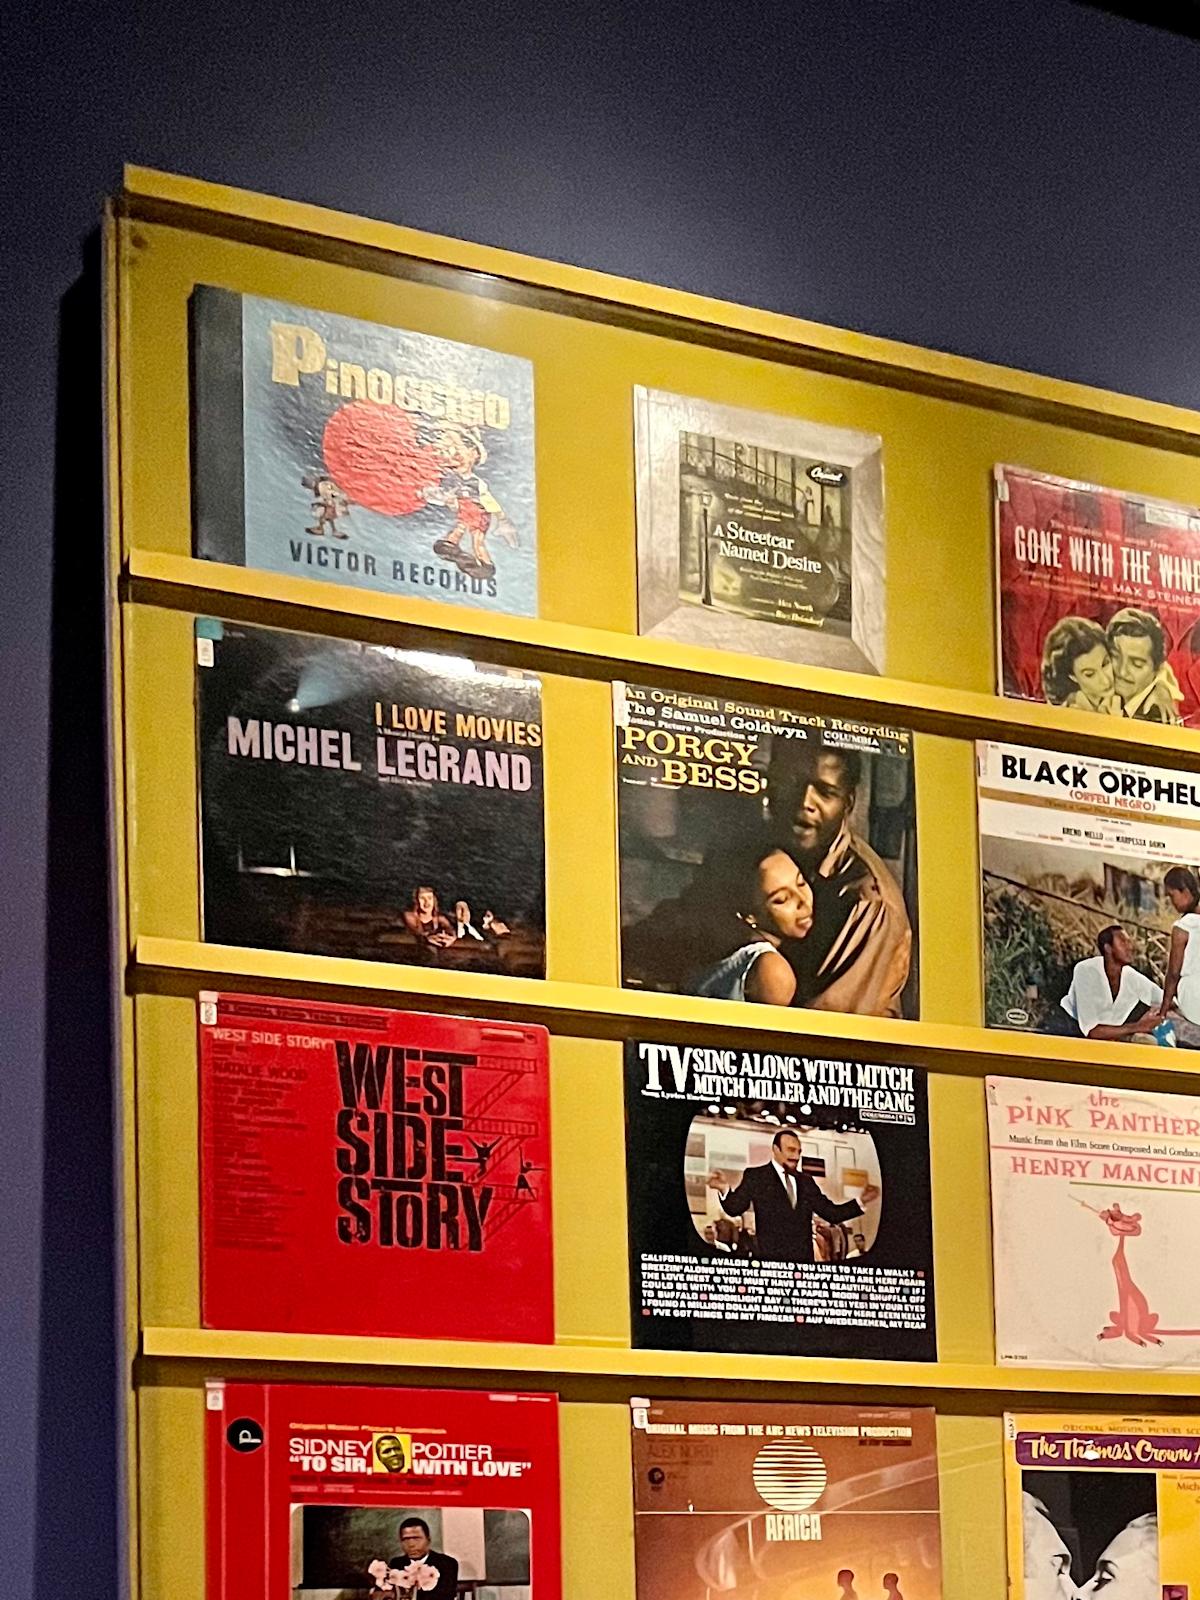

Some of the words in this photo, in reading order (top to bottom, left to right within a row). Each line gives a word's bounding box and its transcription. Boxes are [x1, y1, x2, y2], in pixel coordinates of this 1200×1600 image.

[268, 319, 510, 430] Pinocchio
[713, 525, 724, 537] A
[727, 521, 795, 550] Streetcar
[1014, 525, 1062, 569] GONE
[1069, 536, 1113, 577] WITH
[1120, 546, 1152, 585] THE
[289, 539, 377, 576] VICTOR
[392, 559, 498, 598] RECORDS
[719, 541, 769, 564] Named
[773, 550, 822, 573] Desire
[1113, 584, 1141, 597] MAX
[374, 701, 383, 726] I
[392, 704, 447, 735] LOVE
[456, 712, 542, 747] MOVIES
[624, 687, 646, 701] An
[650, 690, 719, 712] Original
[725, 697, 775, 721] Sound
[779, 711, 826, 729] Track
[831, 718, 909, 742] Recording
[624, 700, 655, 716] The
[661, 706, 726, 727] Samuel
[731, 717, 808, 740] Goldwyn
[228, 715, 362, 772] MICHEL
[377, 736, 532, 792] LEGRAND
[621, 727, 758, 766] PORGY
[622, 754, 657, 768] AND
[662, 758, 760, 794] BESS
[1001, 754, 1088, 788] BLACK
[334, 1039, 478, 1117] WEST
[639, 1043, 693, 1092] TV
[692, 1048, 737, 1075] SING
[739, 1052, 801, 1081] ALONG
[802, 1058, 853, 1086] WITH
[855, 1063, 914, 1092] MITCH
[693, 1073, 746, 1098] MITCH
[747, 1078, 806, 1103] MILLER
[807, 1084, 840, 1106] AND
[840, 1087, 873, 1111] THE
[874, 1090, 915, 1112] GANG
[1090, 1090, 1120, 1108] the
[1006, 1096, 1072, 1129] PINK
[1090, 1109, 1200, 1137] PANTHER
[336, 1108, 464, 1182] SIDE
[1010, 1156, 1091, 1178] HENRY
[337, 1177, 494, 1252] STORY
[289, 1437, 371, 1456] SIDNEY
[411, 1443, 492, 1460] POITIER
[330, 1458, 373, 1473] SIR,
[412, 1460, 467, 1476] WITH
[1024, 1436, 1058, 1459] The
[1134, 1439, 1190, 1462] Crown
[766, 1513, 822, 1541] AFRICA
